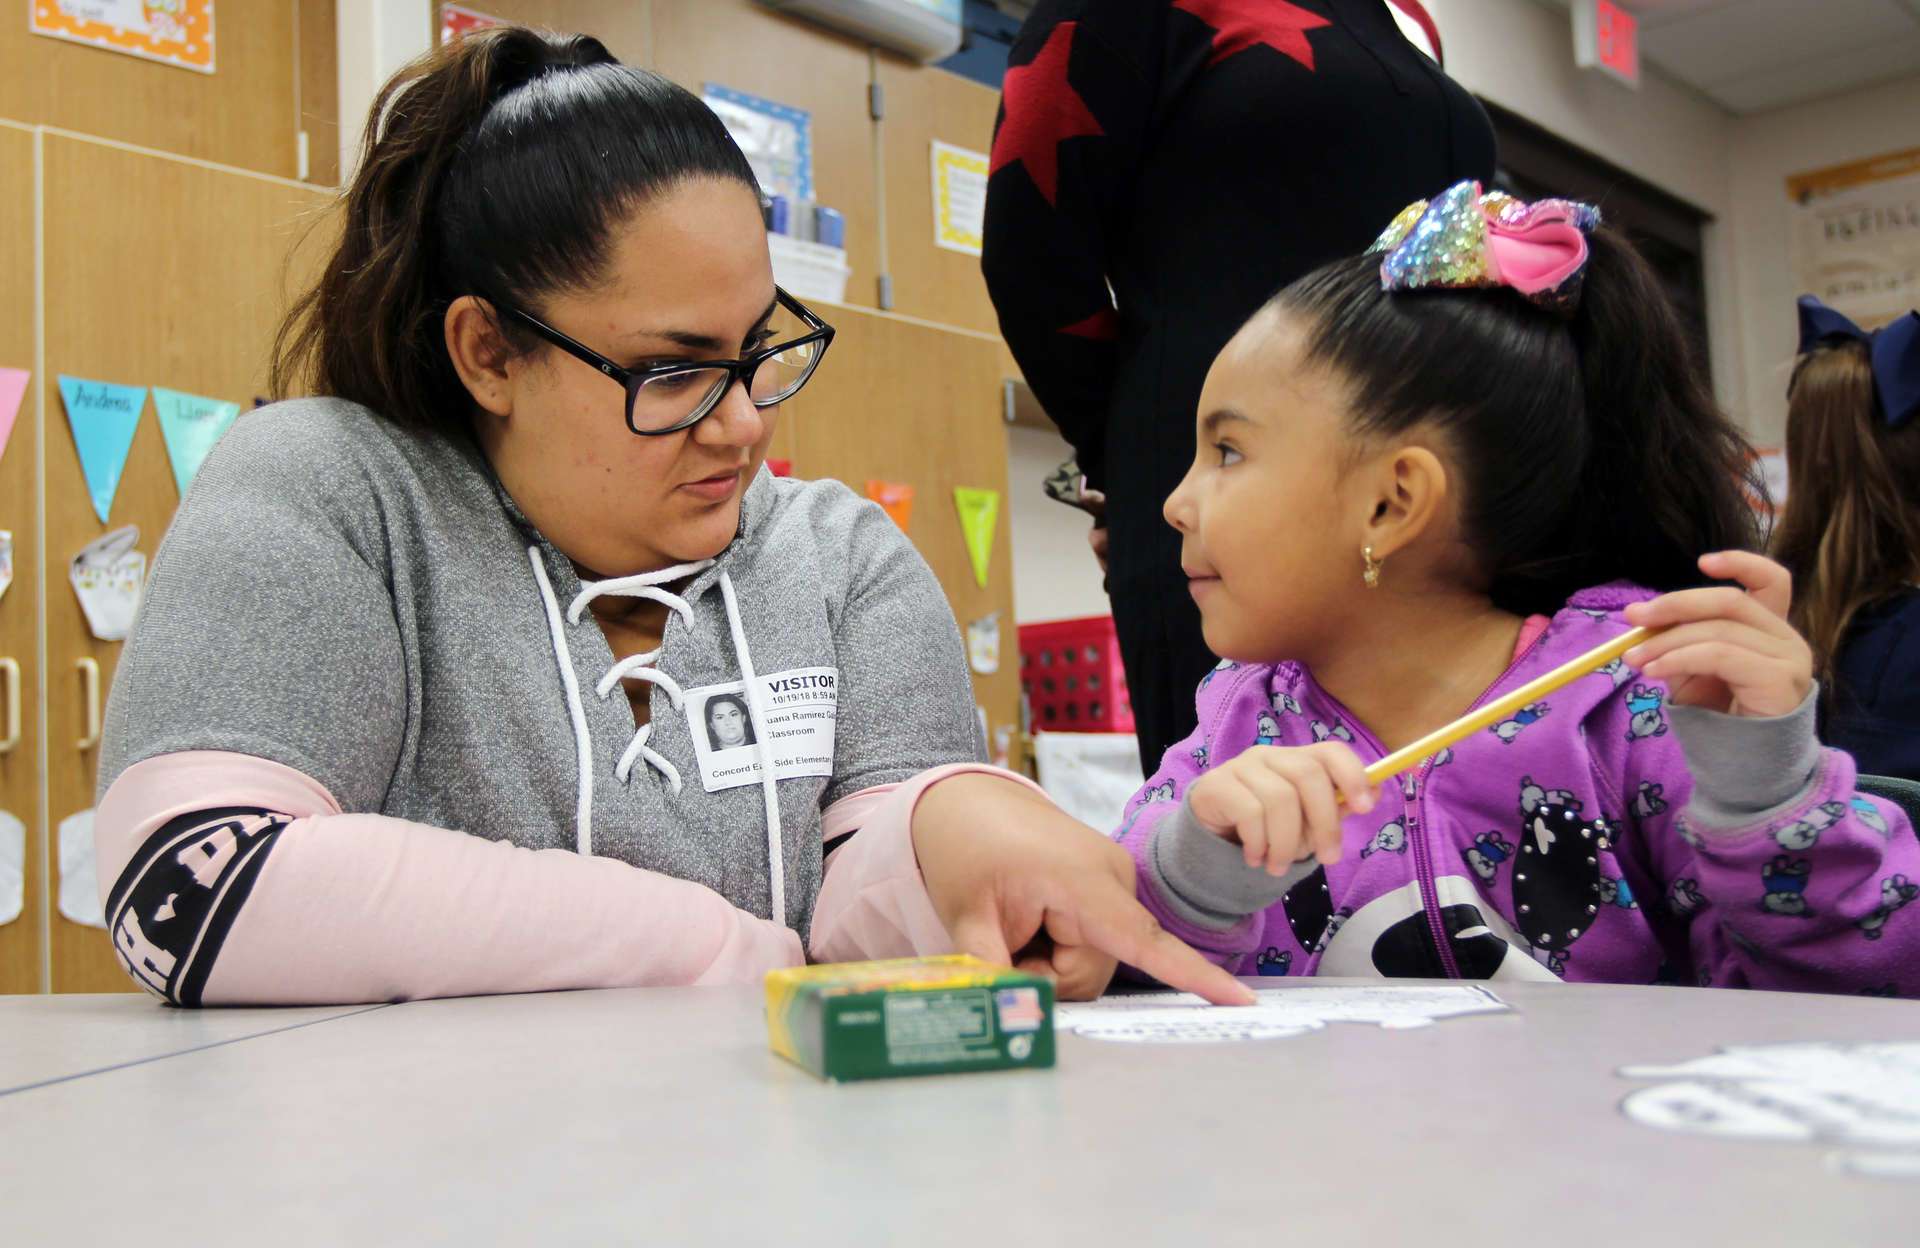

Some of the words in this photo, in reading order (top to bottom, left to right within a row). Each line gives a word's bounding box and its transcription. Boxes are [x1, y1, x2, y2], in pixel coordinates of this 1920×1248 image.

[768, 675, 835, 693] VISITOR
[773, 691, 811, 704] 10/19/18
[812, 691, 828, 700] 8:59
[767, 715, 791, 725] uana
[792, 711, 825, 721] Ramirez
[712, 763, 751, 778] Concord
[774, 757, 794, 768] Side
